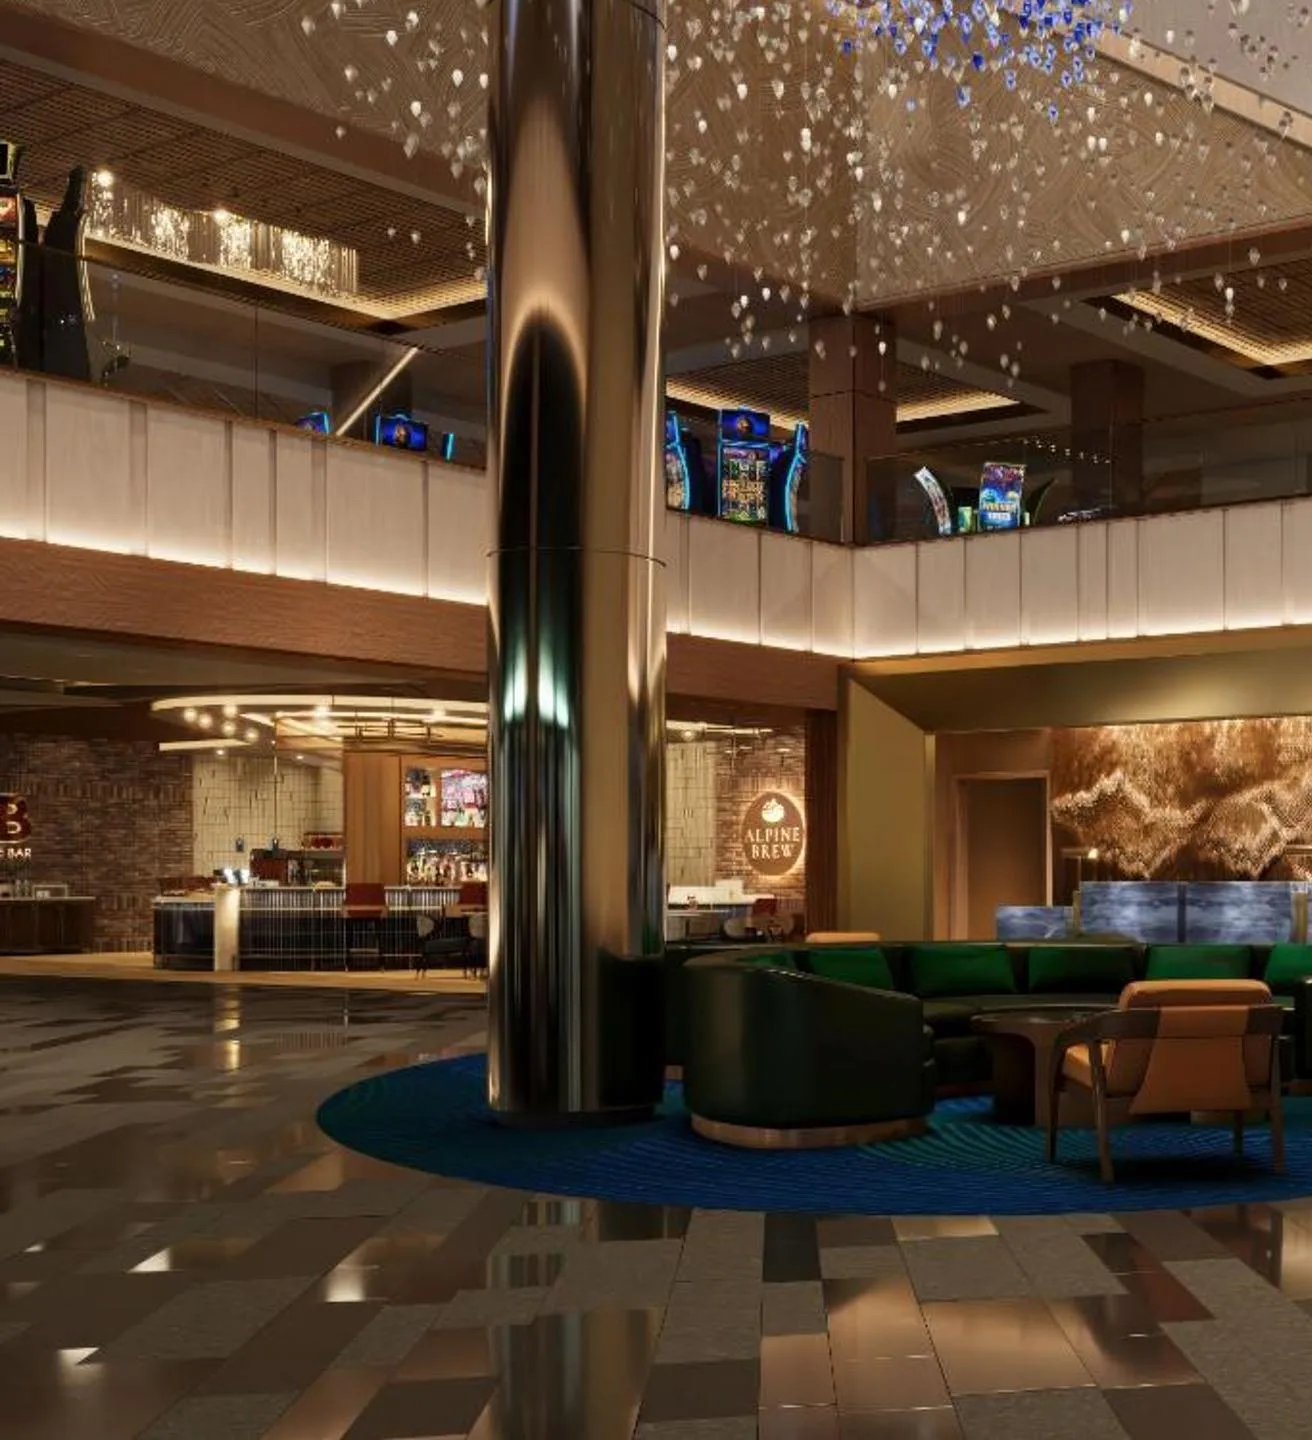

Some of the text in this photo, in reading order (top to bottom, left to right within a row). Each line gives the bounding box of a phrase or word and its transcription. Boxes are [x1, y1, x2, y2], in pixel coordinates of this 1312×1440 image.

[744, 827, 800, 842] ALPINE
[7, 847, 32, 859] BAR
[752, 844, 795, 859] BREW
